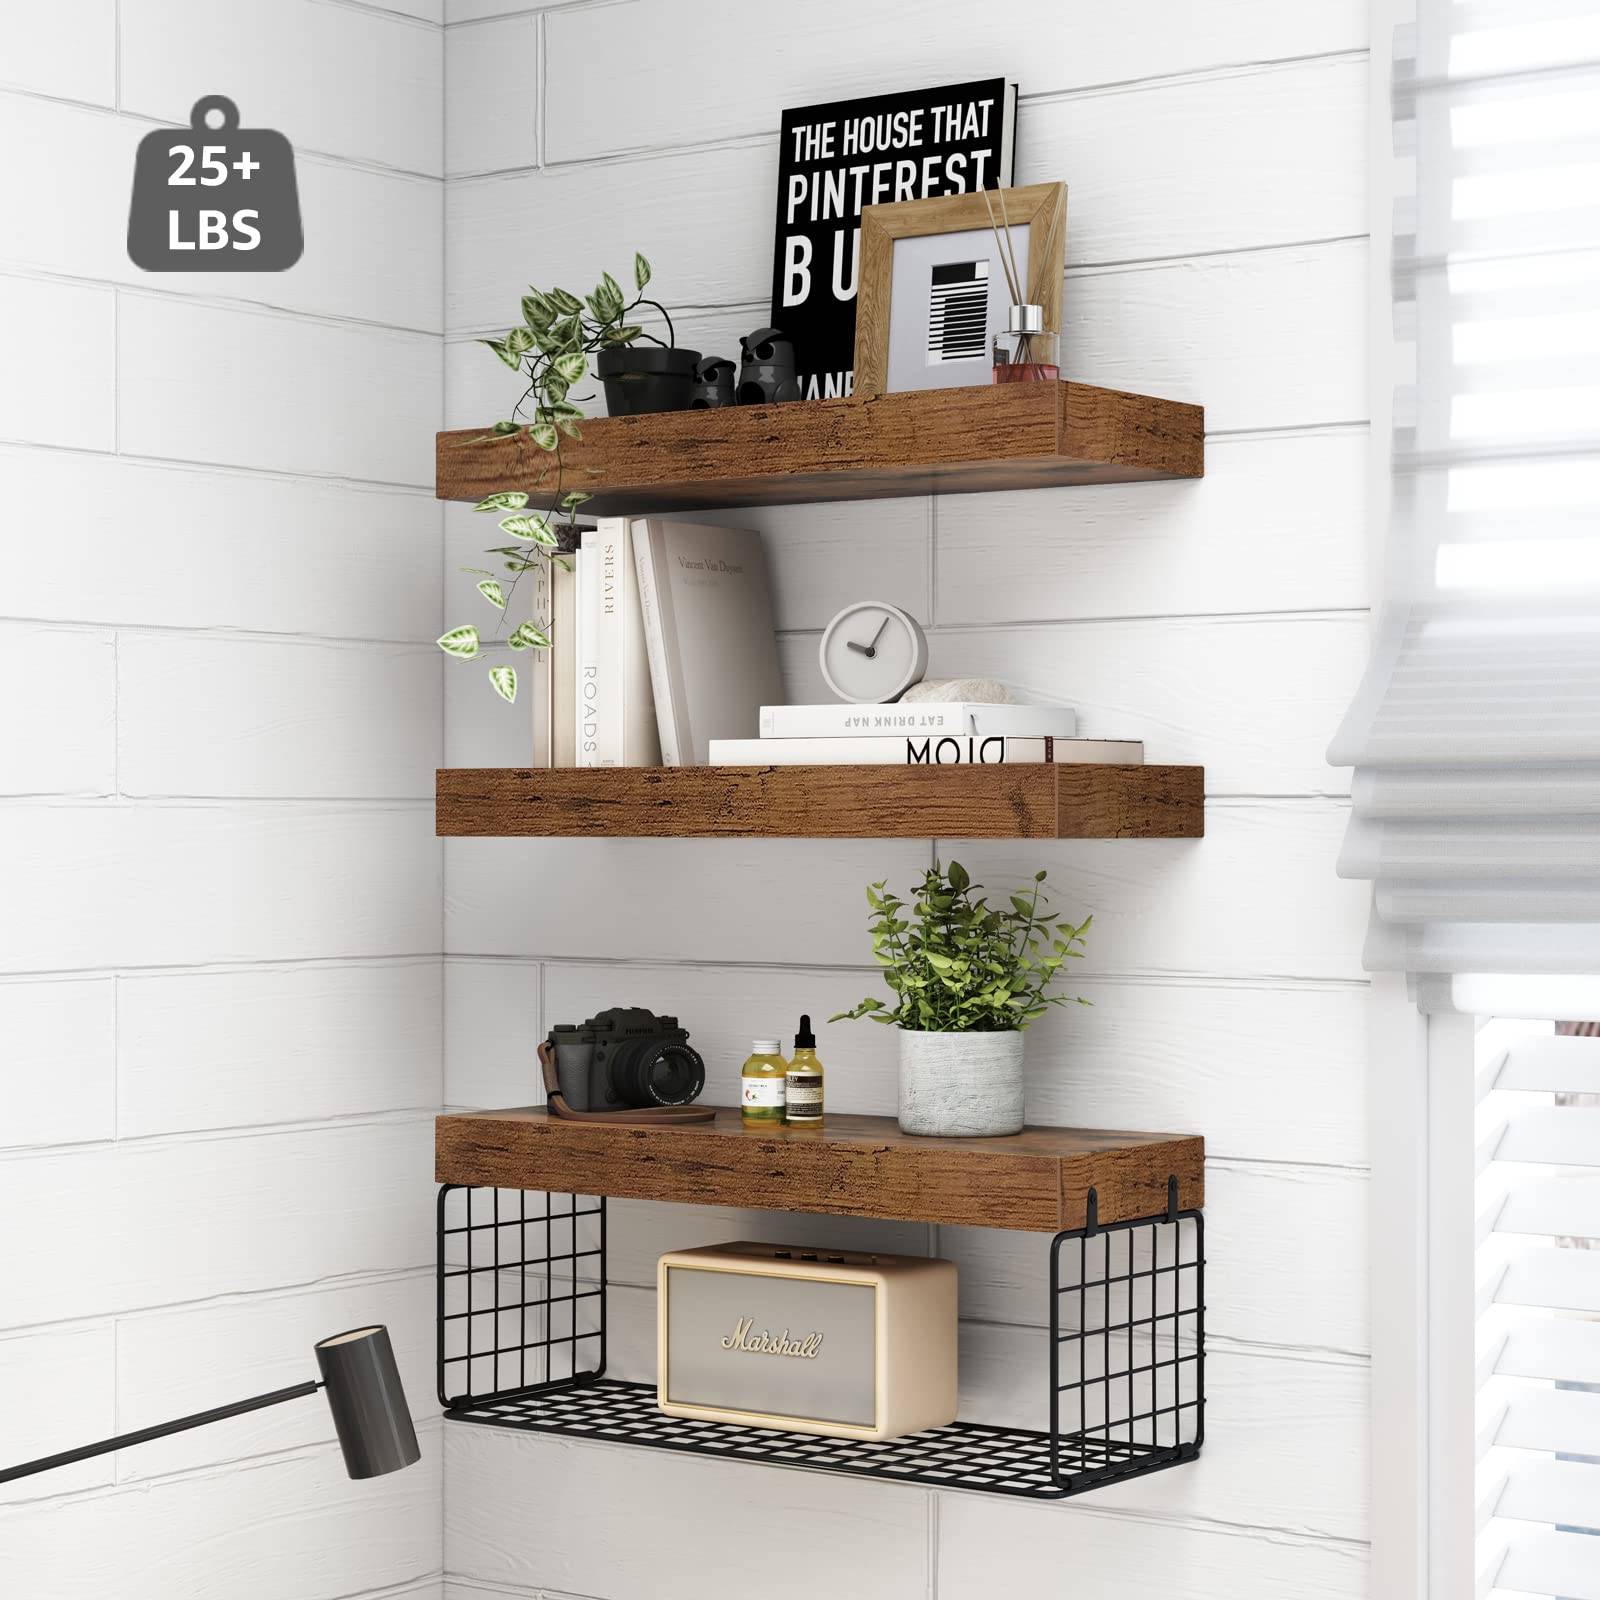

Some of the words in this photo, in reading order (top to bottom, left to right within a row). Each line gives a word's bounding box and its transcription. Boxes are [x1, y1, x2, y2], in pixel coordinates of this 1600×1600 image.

[791, 121, 836, 163] THE
[842, 109, 924, 156] HOUSE
[931, 99, 994, 144] THAT
[786, 148, 992, 225] PINTEREST
[604, 544, 615, 614] RIVERS
[678, 555, 704, 570] Vincent
[704, 558, 719, 571] Van
[537, 544, 547, 664] RAPHAL
[583, 665, 597, 753] ROADS
[844, 716, 870, 728] NAP
[874, 715, 915, 727] DRINK
[919, 715, 944, 726] EAT
[720, 1317, 824, 1360] Marshall
